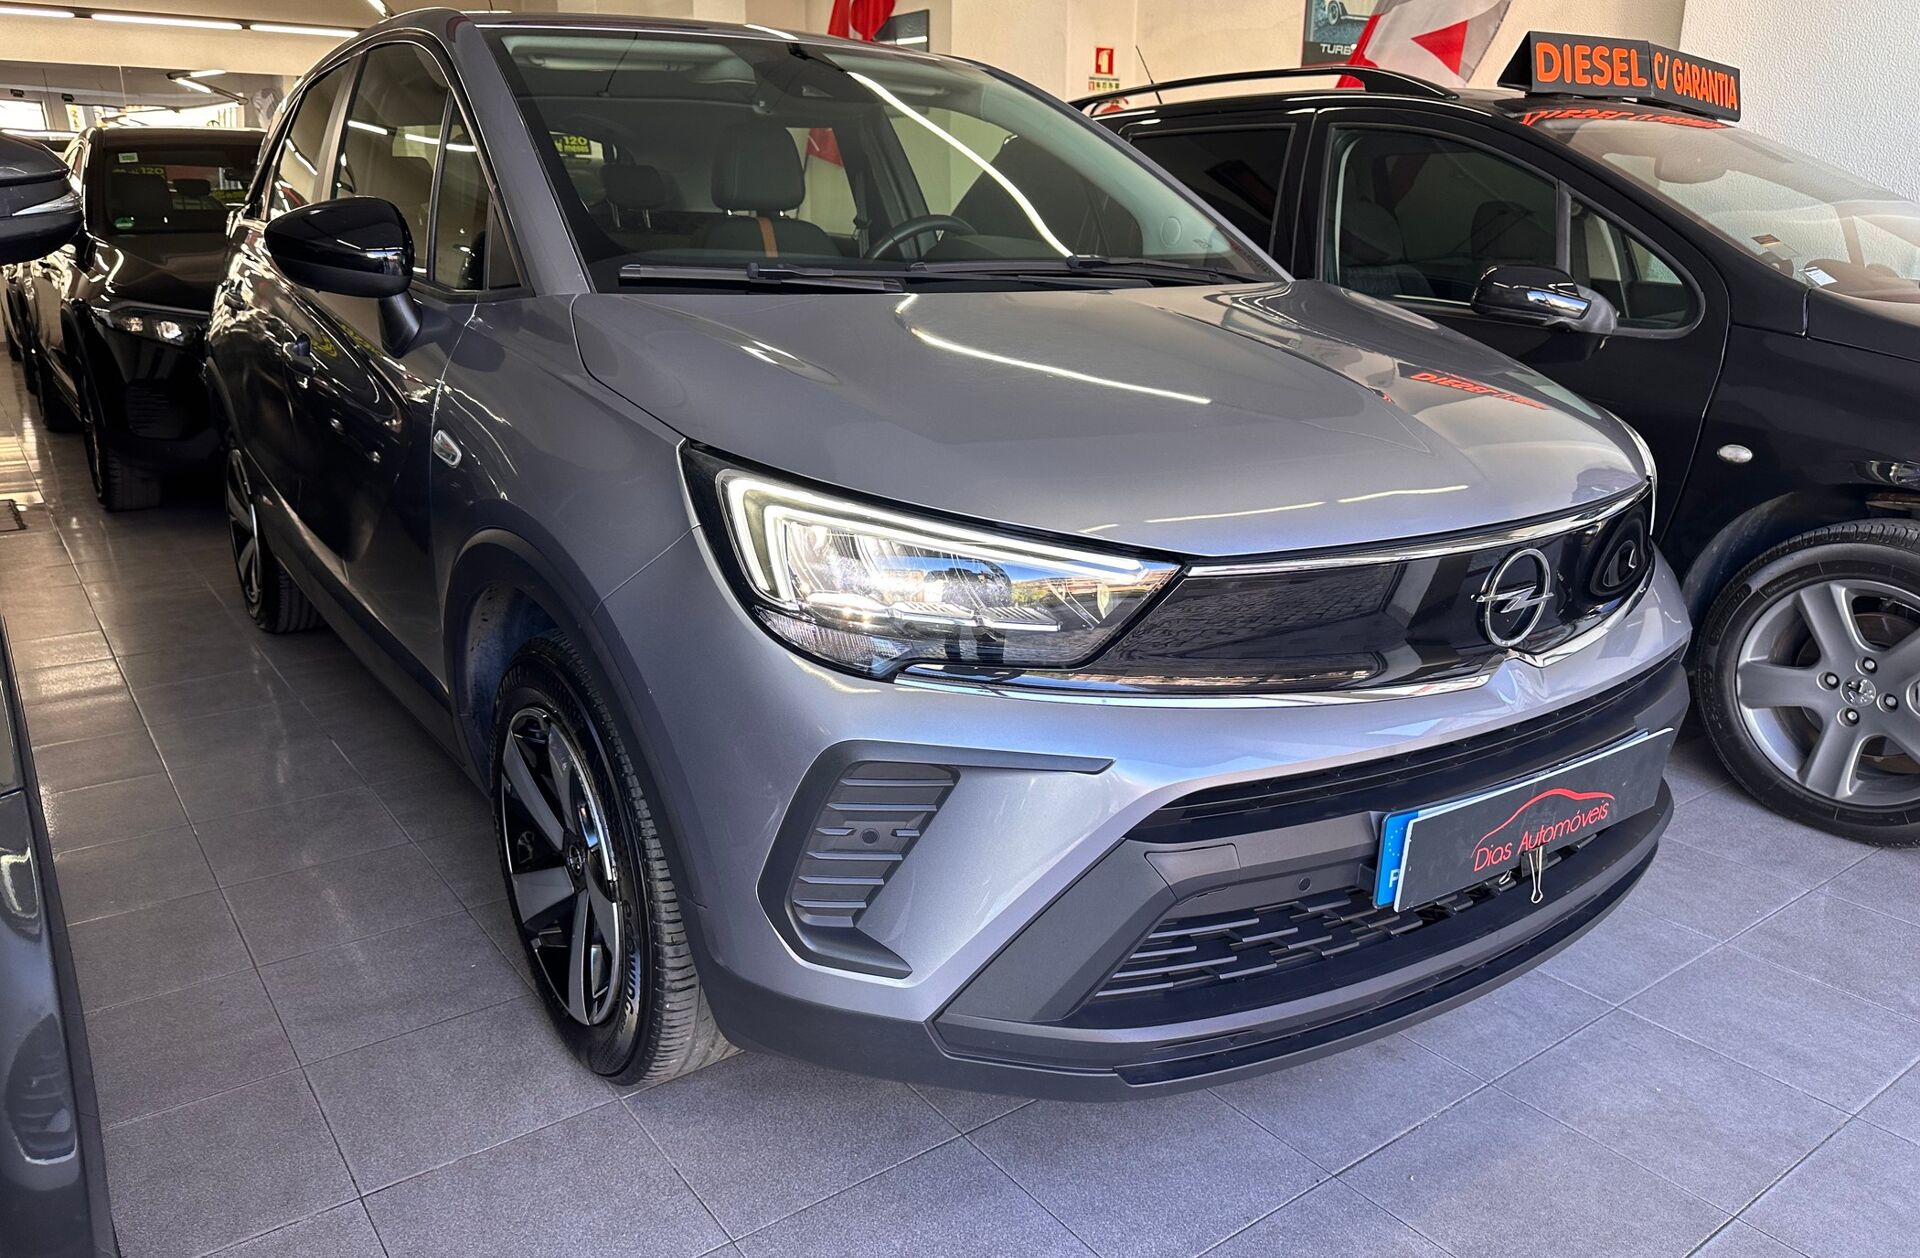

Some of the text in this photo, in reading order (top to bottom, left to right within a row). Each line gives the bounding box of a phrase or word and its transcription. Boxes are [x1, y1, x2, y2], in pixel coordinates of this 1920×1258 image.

[1320, 43, 1356, 56] TURB
[1535, 41, 1738, 111] DIESEL C/ GARANTIA
[563, 136, 588, 146] 120
[140, 167, 164, 175] 120
[1473, 800, 1610, 872] Dias Automóveis
[1388, 868, 1401, 888] P
